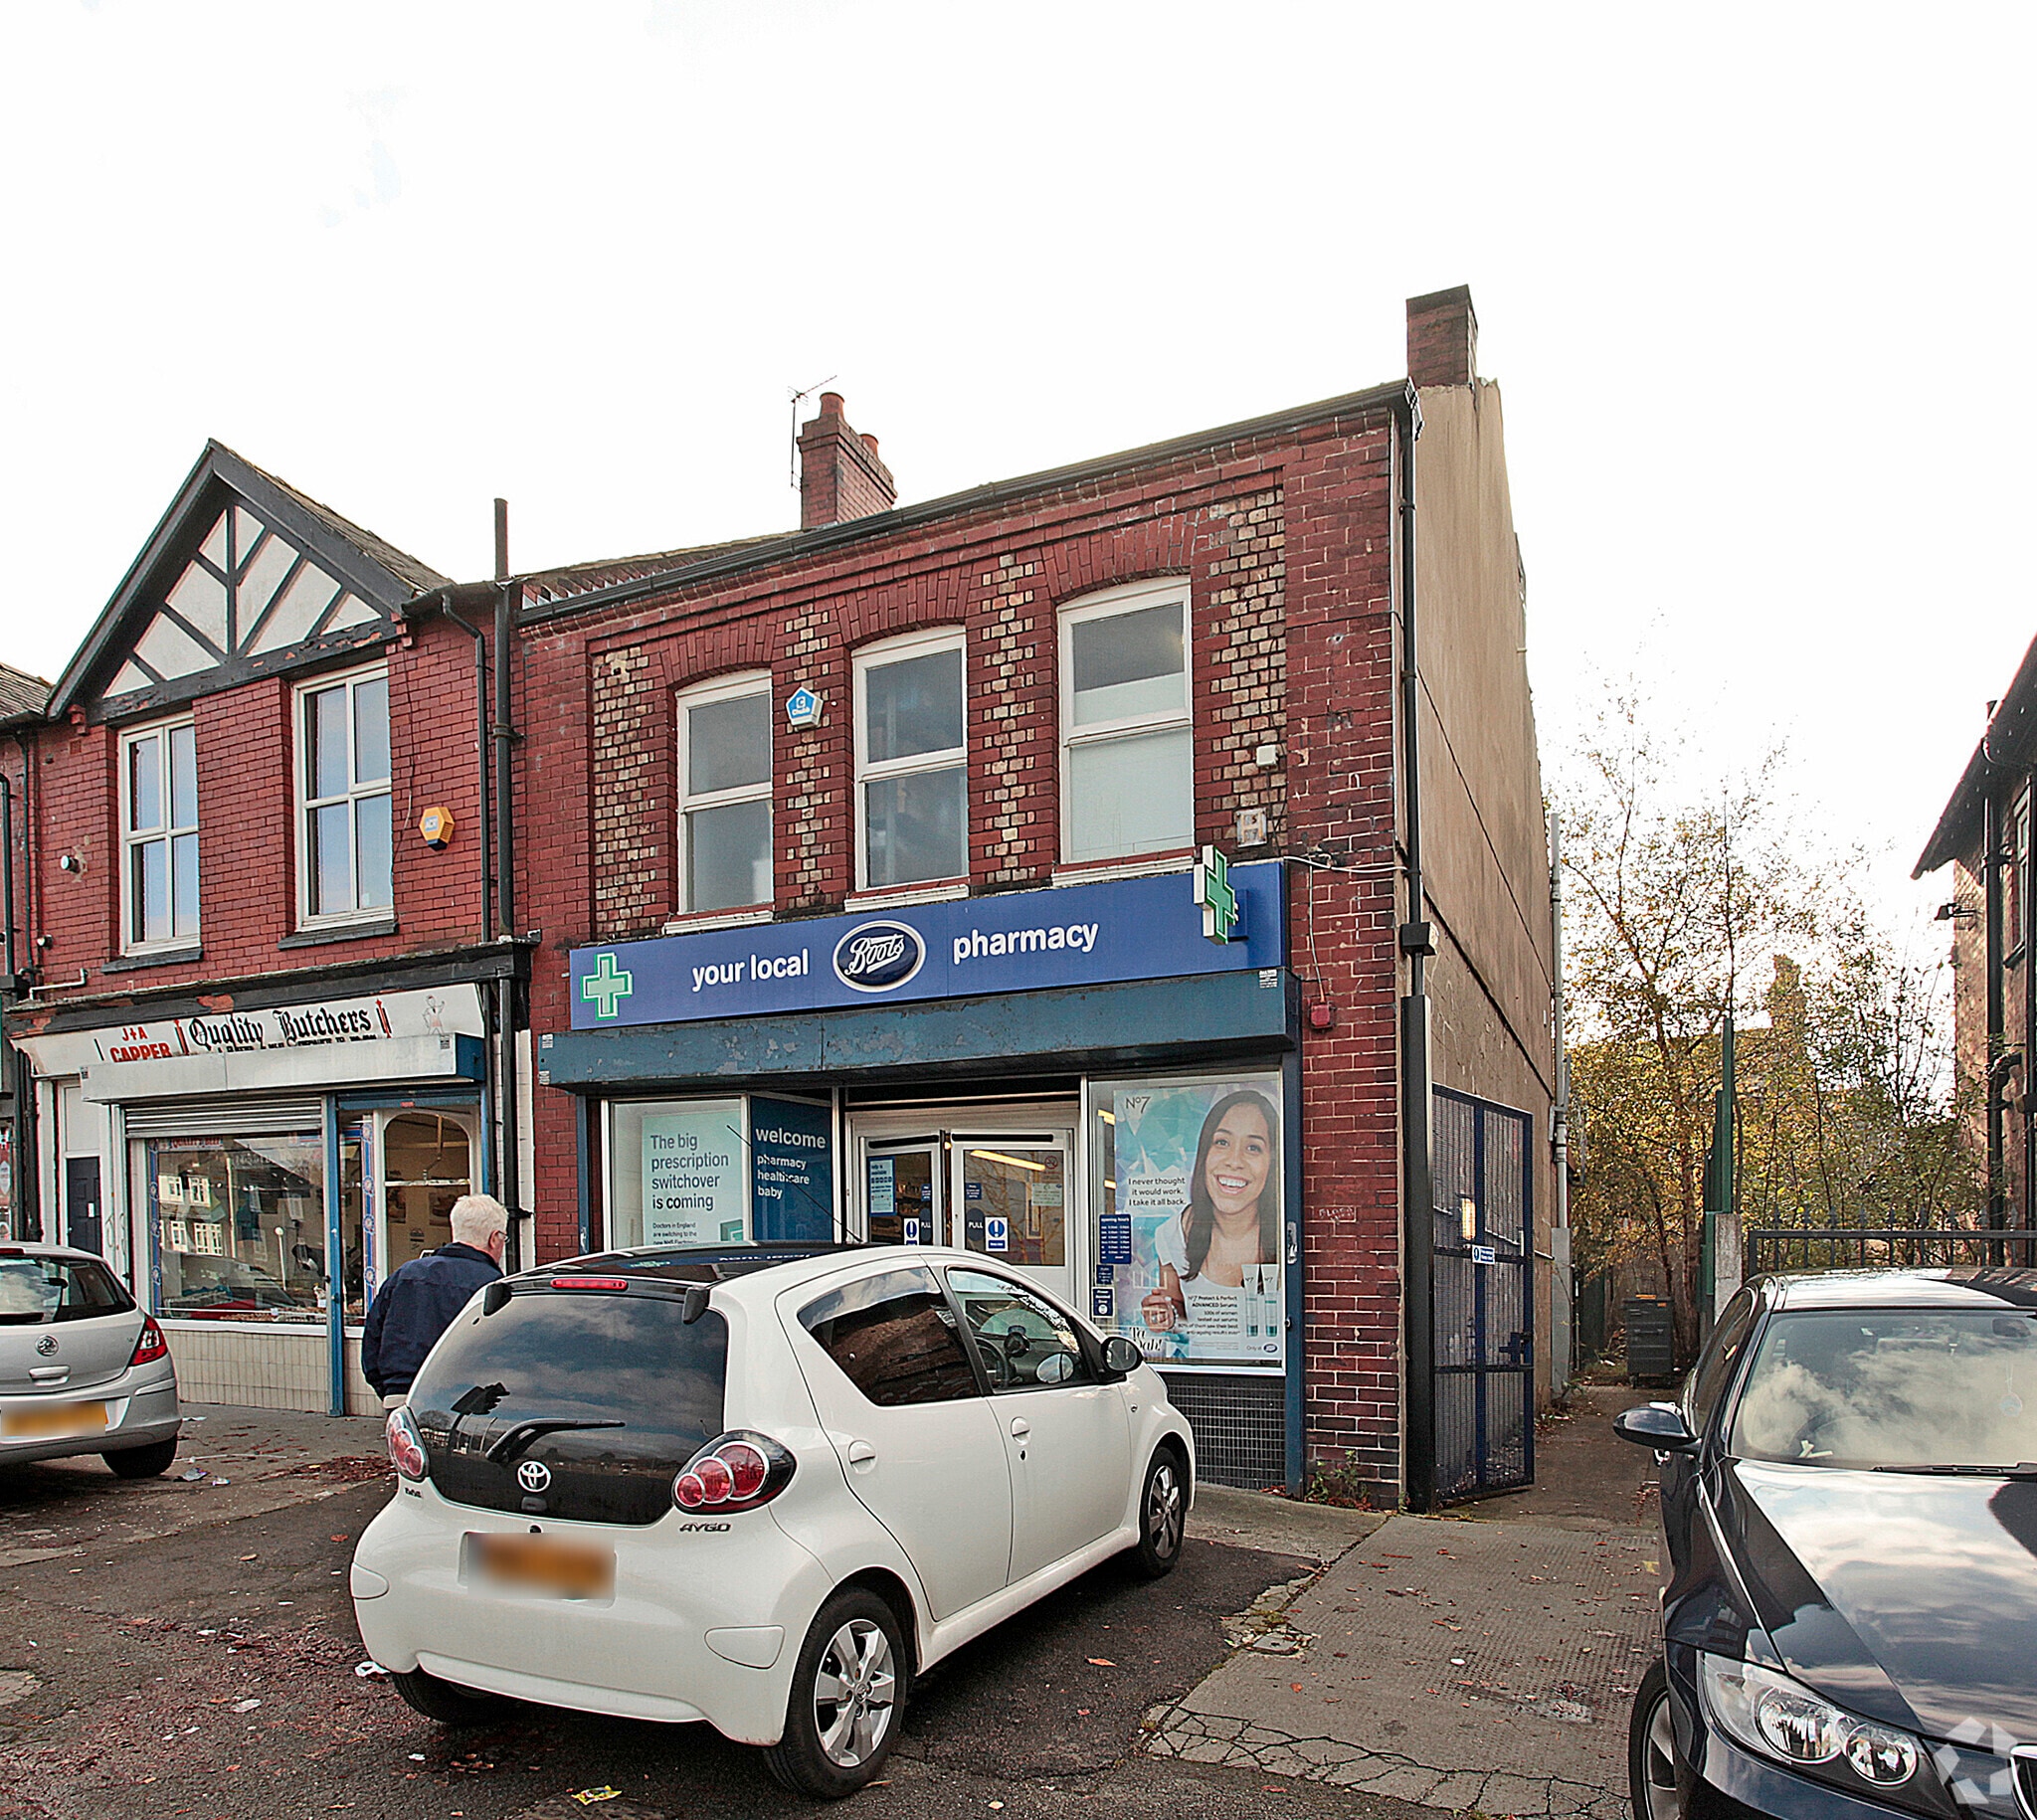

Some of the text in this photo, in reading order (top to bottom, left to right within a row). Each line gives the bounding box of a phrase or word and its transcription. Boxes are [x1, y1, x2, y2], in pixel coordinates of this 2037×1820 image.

[692, 922, 1100, 993] your local Boots pharmacy
[188, 1013, 264, 1051] Quality
[272, 1006, 372, 1043] Butchers
[109, 1041, 173, 1063] CAPPER
[650, 1133, 698, 1152] The big
[755, 1127, 827, 1149] welcome
[651, 1152, 729, 1173] prescription
[757, 1154, 807, 1171] pharmacy
[651, 1173, 720, 1189] switchover
[757, 1170, 811, 1184] healthcare
[1155, 1177, 1186, 1187] thought
[757, 1184, 783, 1200] baby
[1138, 1186, 1161, 1195] would
[651, 1193, 714, 1211] is coming
[1157, 1197, 1166, 1206] all
[1167, 1197, 1187, 1206] back.
[679, 1522, 731, 1533] AYGO
